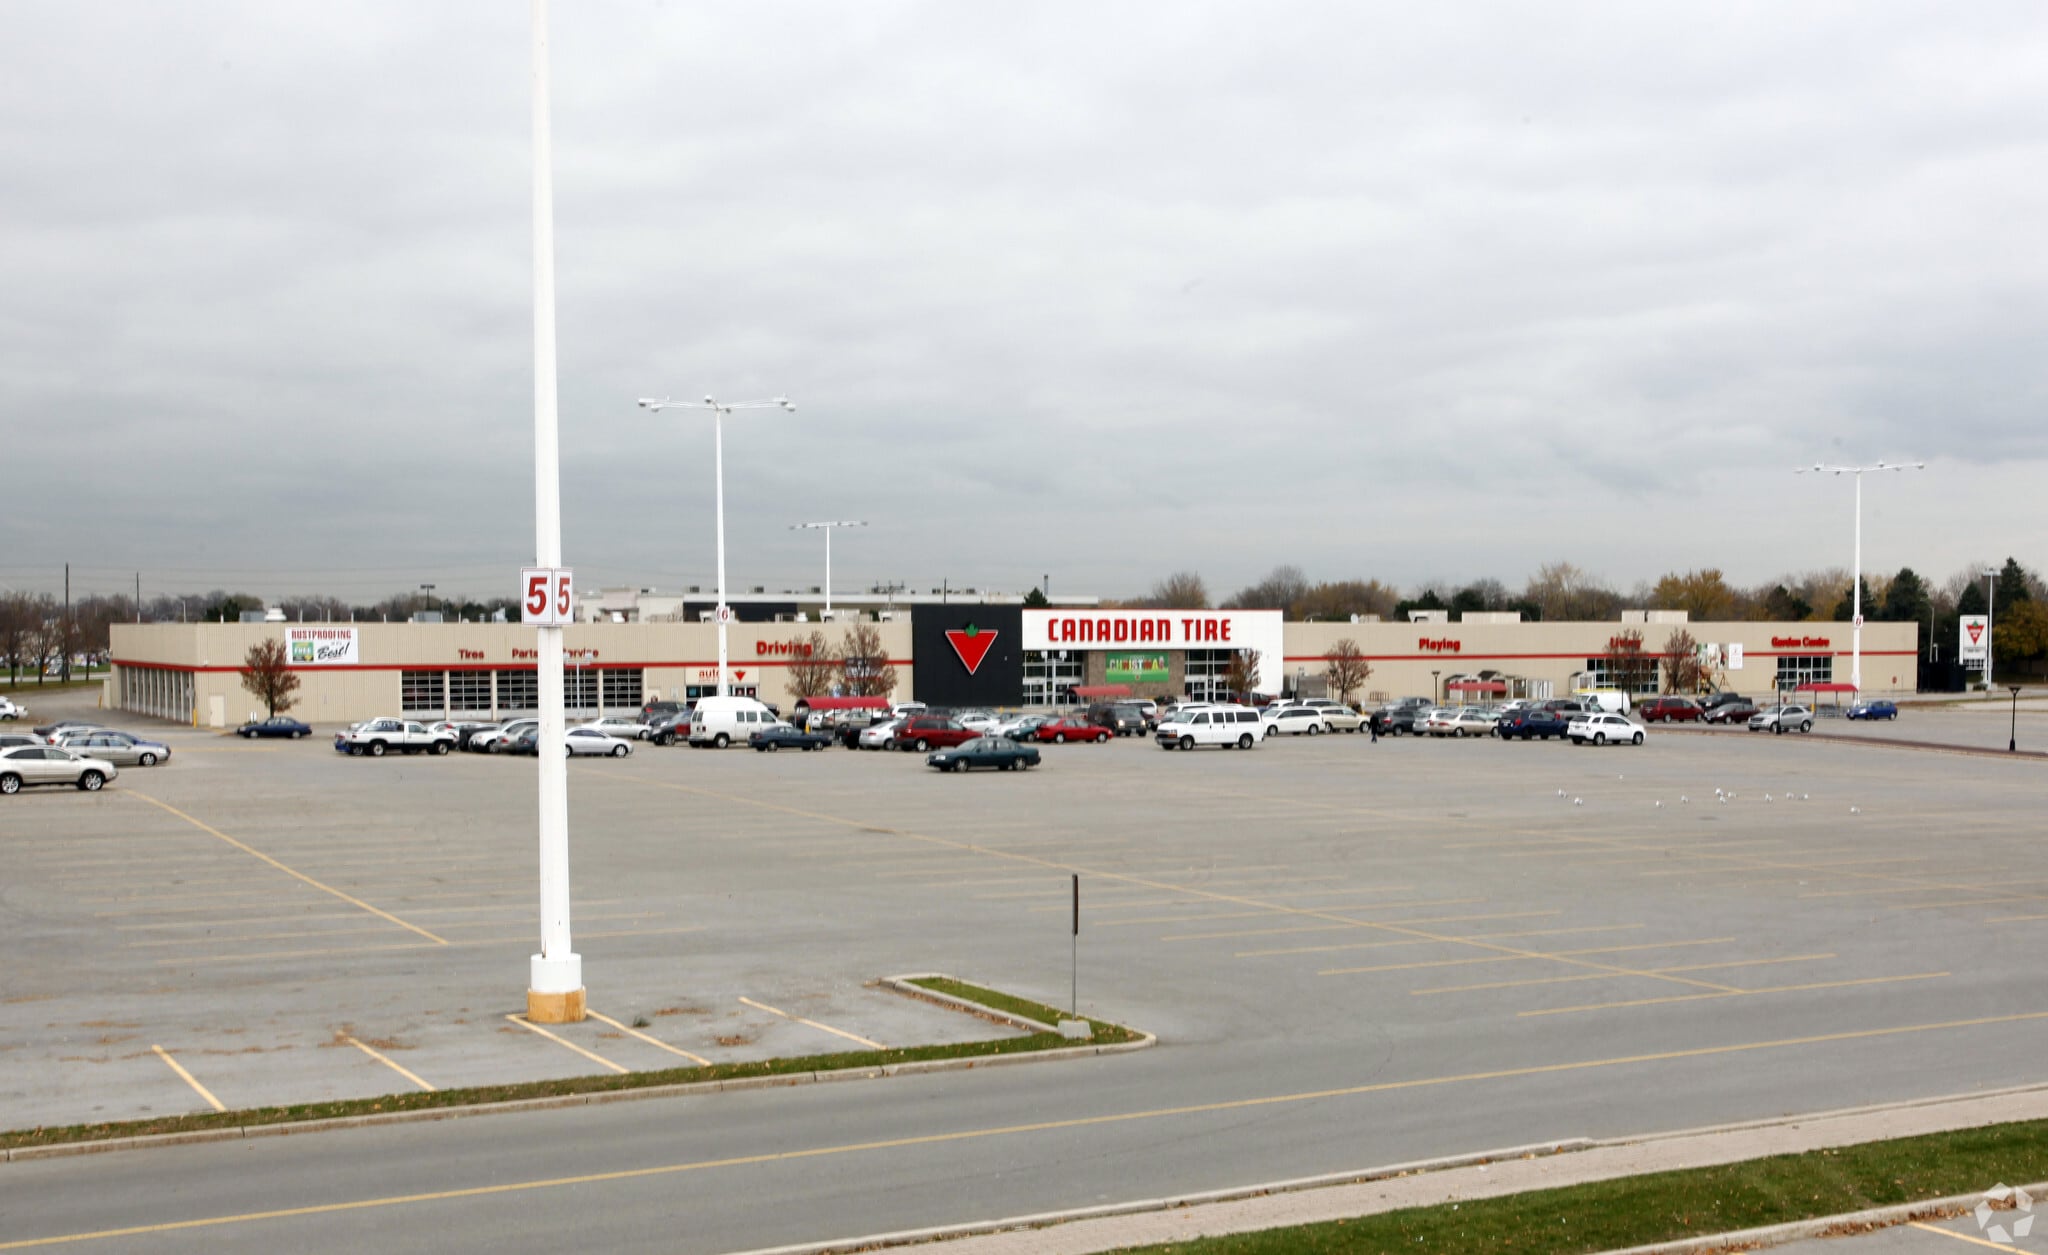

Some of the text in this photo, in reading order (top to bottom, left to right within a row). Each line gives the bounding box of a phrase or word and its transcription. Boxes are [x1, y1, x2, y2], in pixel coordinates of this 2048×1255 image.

[526, 576, 548, 616] 5
[557, 577, 571, 616] 5
[291, 630, 351, 640] RUSTPROOFING
[1048, 618, 1232, 642] CANADIAN TIRE
[317, 641, 350, 659] Best!
[756, 640, 813, 658] Driving
[1418, 637, 1461, 652] Playing
[1771, 636, 1801, 648] Garden
[459, 649, 485, 659] Tires
